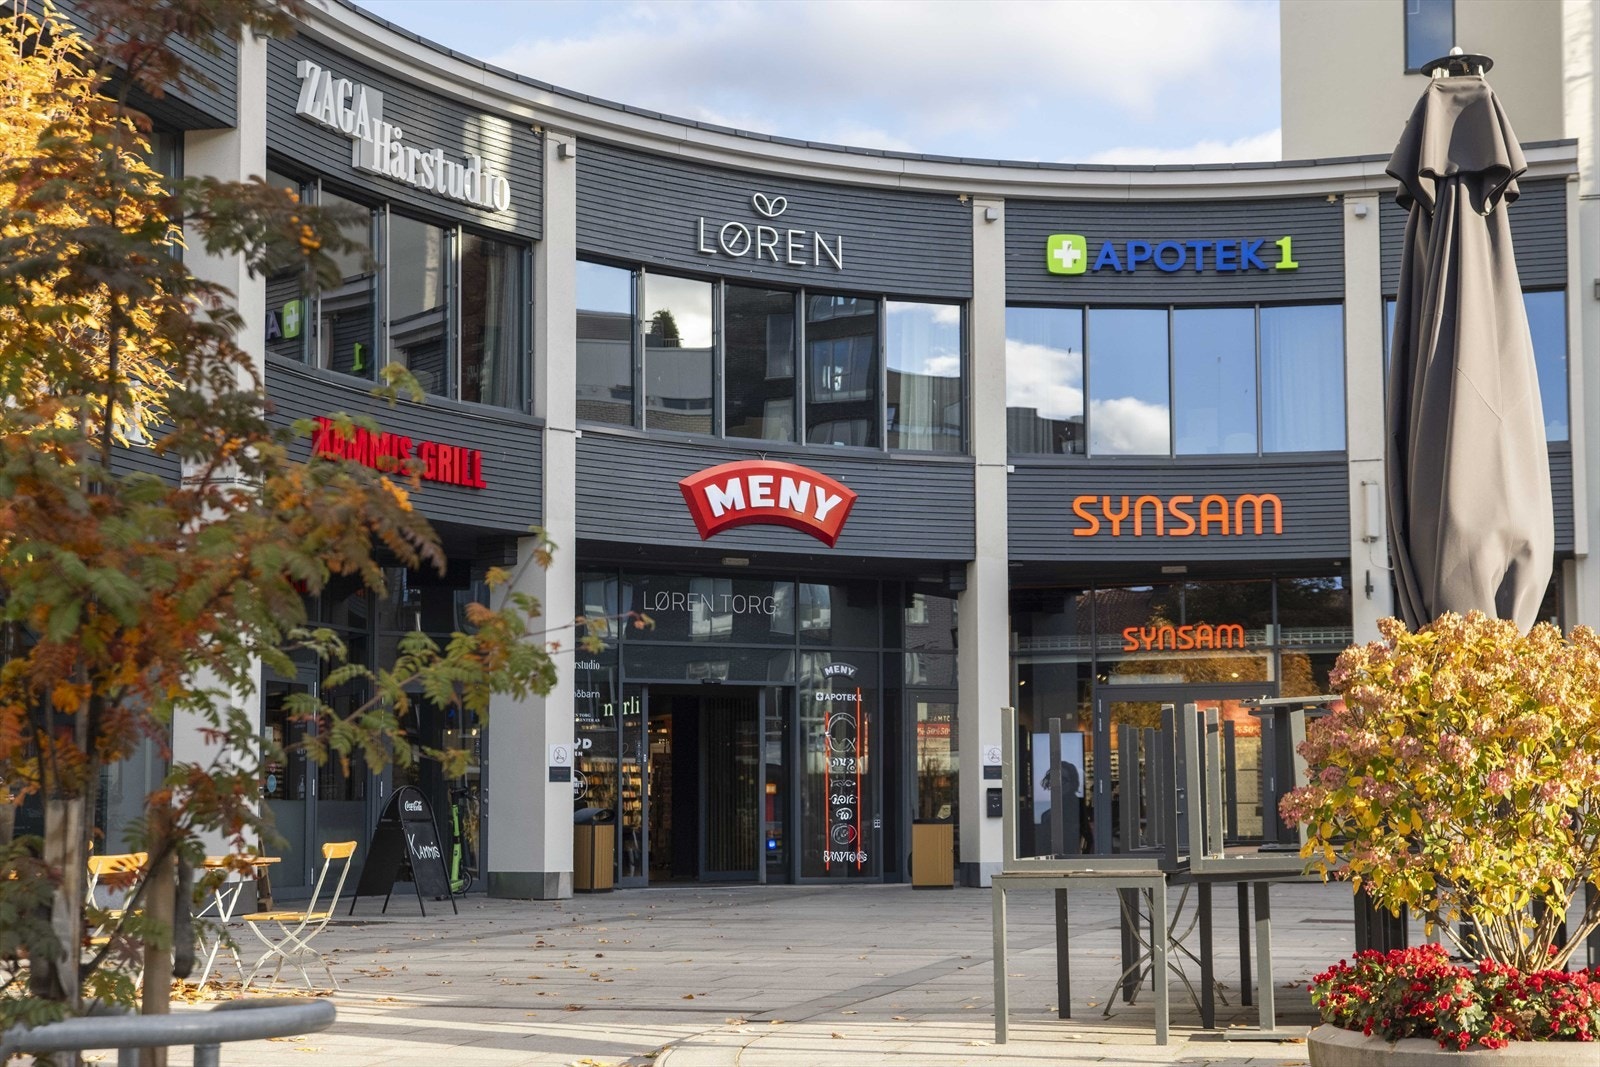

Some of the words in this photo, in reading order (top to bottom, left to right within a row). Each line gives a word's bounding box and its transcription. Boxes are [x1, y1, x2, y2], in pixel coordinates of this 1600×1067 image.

[296, 60, 374, 143] ZAGA
[372, 117, 511, 212] Hårstudio
[699, 217, 843, 271] LØREN
[1092, 238, 1269, 273] APOTEK
[1276, 236, 1299, 270] 1
[417, 441, 487, 489] GRILL
[704, 475, 843, 522] MENY
[1072, 494, 1283, 536] SYNSAM
[643, 591, 714, 612] LØREN
[720, 594, 777, 615] TORG
[1123, 624, 1245, 651] SYNSAM
[824, 665, 855, 676] MENY
[604, 696, 640, 716] nrli
[825, 693, 857, 702] APOTEK
